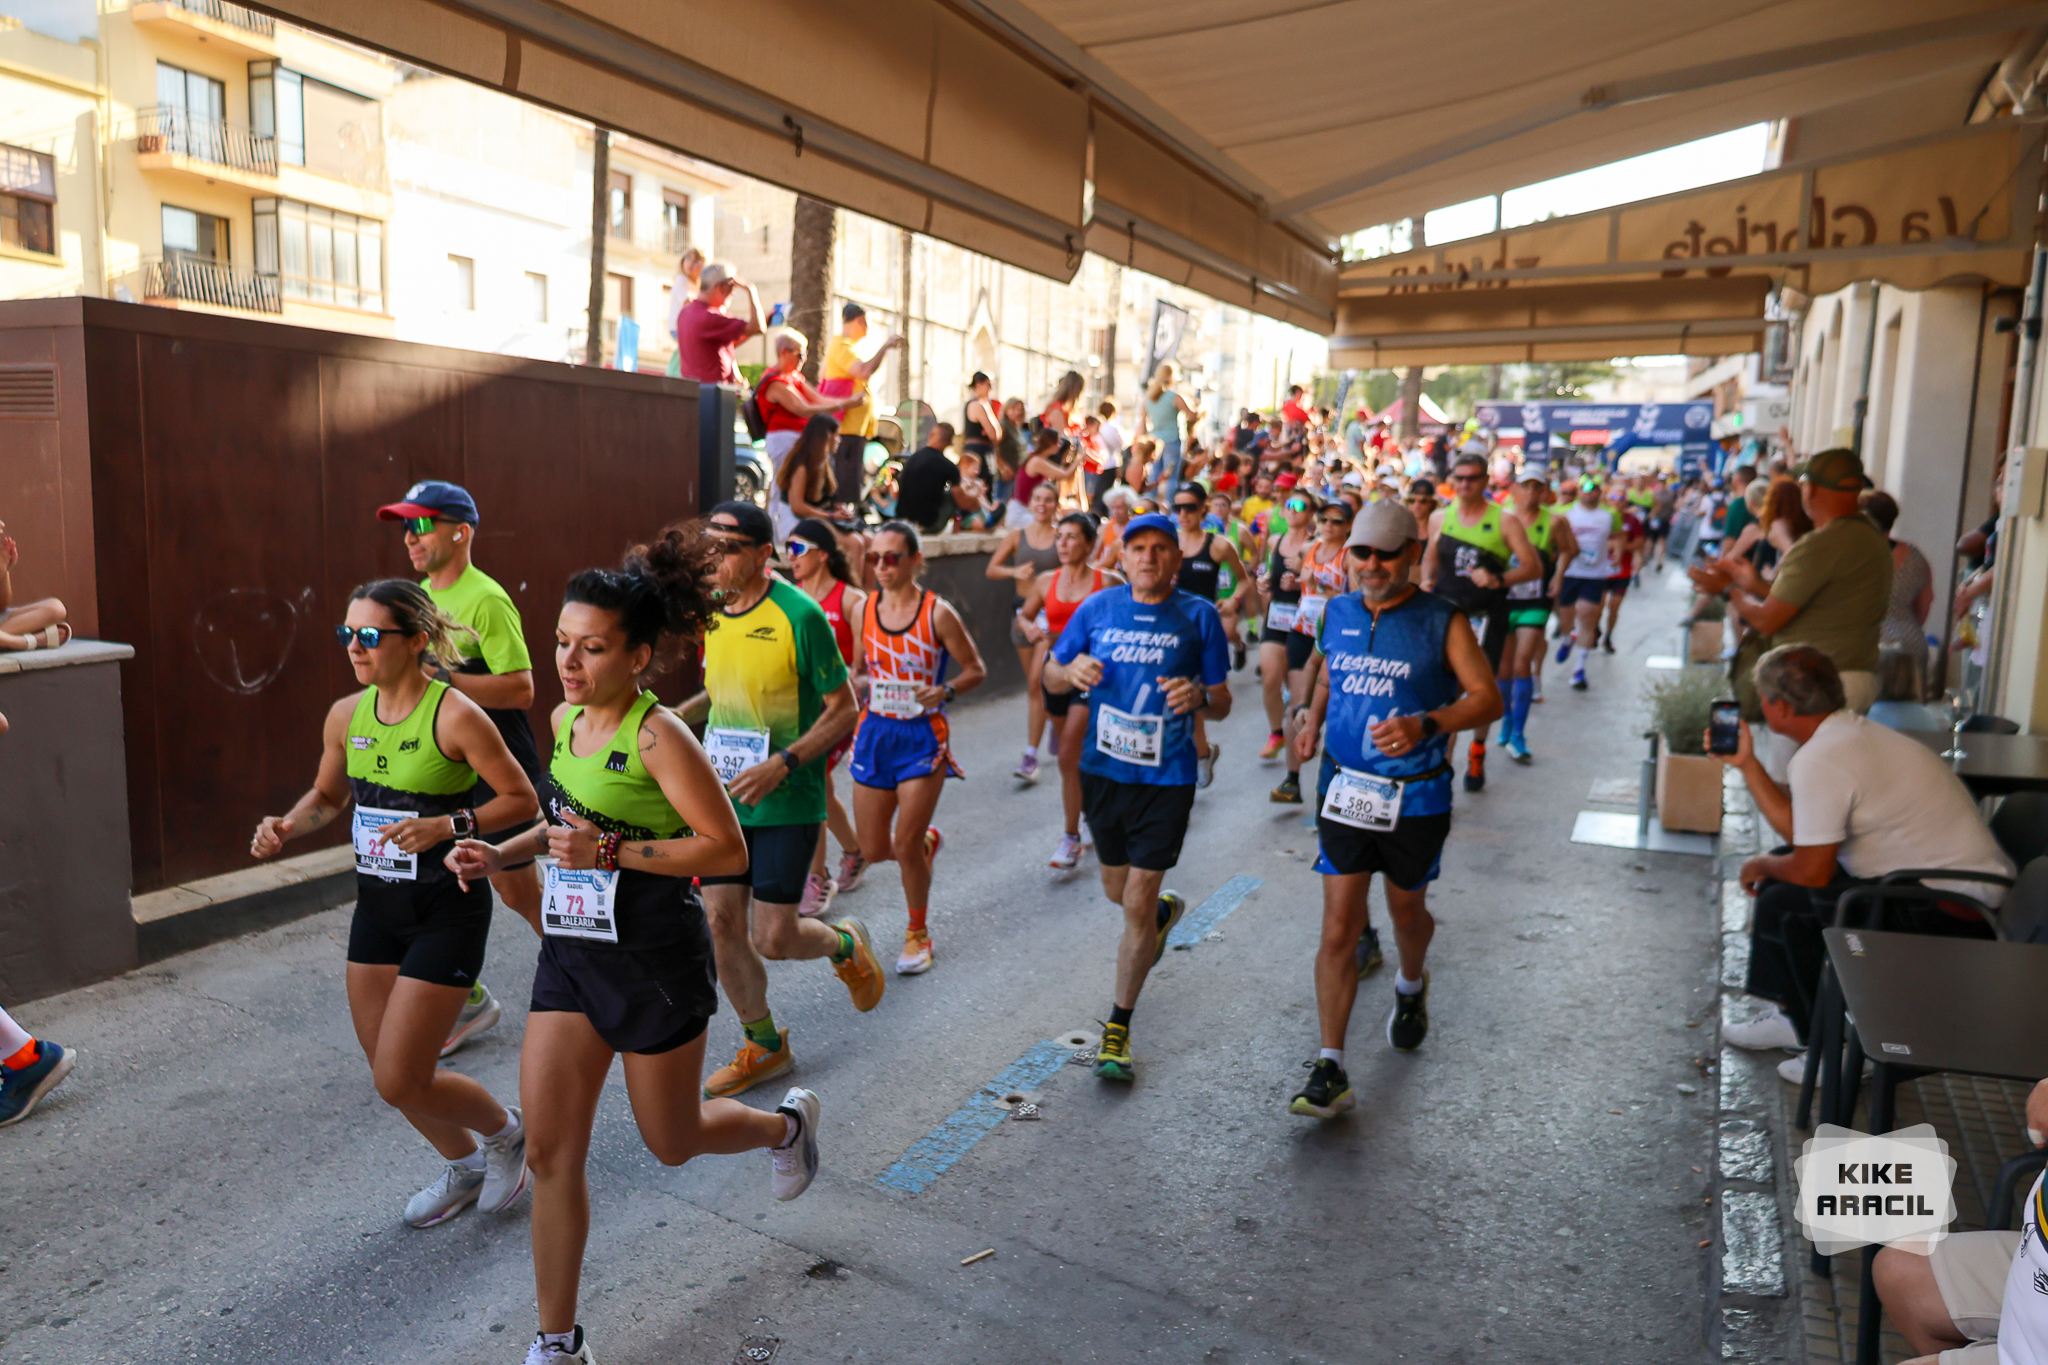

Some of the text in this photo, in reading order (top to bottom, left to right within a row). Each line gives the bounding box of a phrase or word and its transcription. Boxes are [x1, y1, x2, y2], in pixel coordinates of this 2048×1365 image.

[1102, 627, 1180, 648] L'ESPENTA
[1111, 646, 1165, 665] OLIVA
[1331, 653, 1411, 679] L'ESPENTA
[1342, 674, 1395, 697] OLIVA
[1114, 734, 1137, 749] 614
[606, 762, 630, 773] AMS
[723, 755, 746, 769] 947
[1334, 792, 1373, 814] E 580
[1340, 808, 1376, 824] BALEARIA
[360, 855, 395, 868] BALEARIA
[549, 895, 585, 915] A 72
[560, 915, 597, 928] BALEARIA
